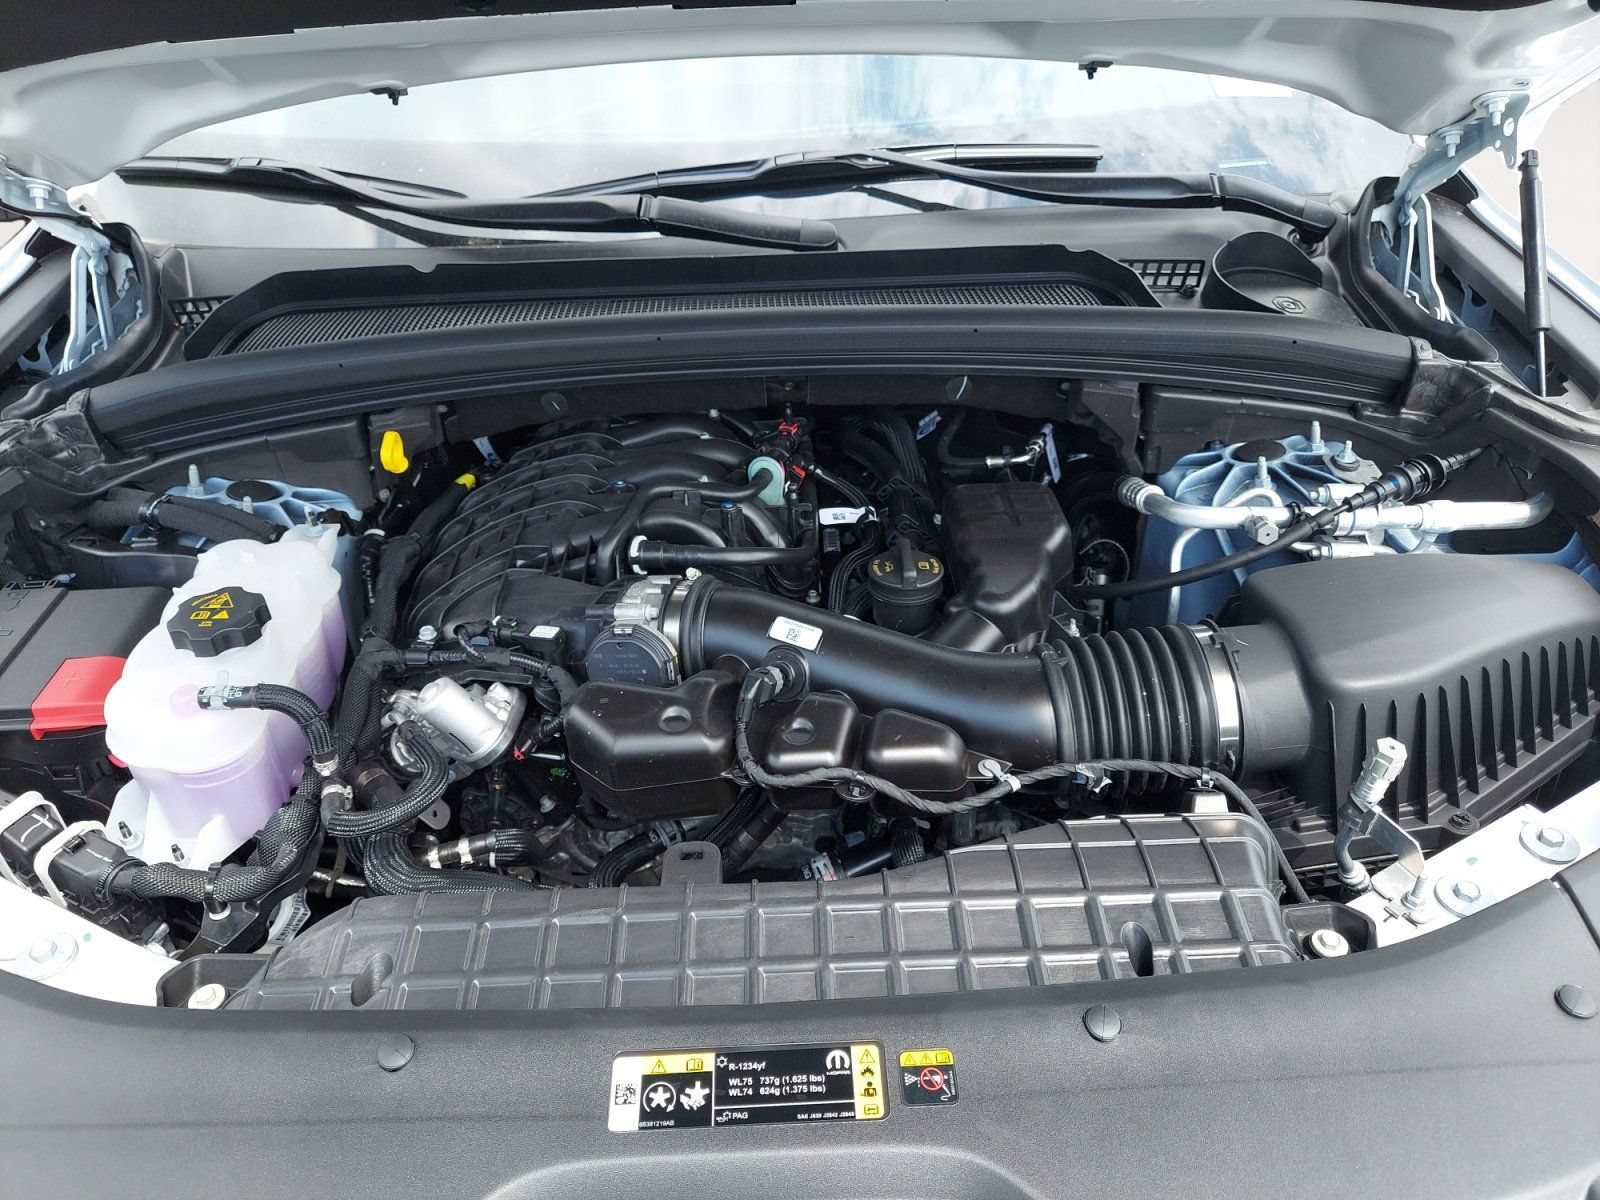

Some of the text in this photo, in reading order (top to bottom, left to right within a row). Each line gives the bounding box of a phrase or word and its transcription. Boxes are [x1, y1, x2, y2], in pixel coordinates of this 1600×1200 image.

[728, 1061, 766, 1071] R-1234yf
[728, 1074, 826, 1087] WL75 737g (1.625 lbs)
[728, 1084, 826, 1097] WL74 624g (1.375 lbs)
[732, 1111, 749, 1120] PAG
